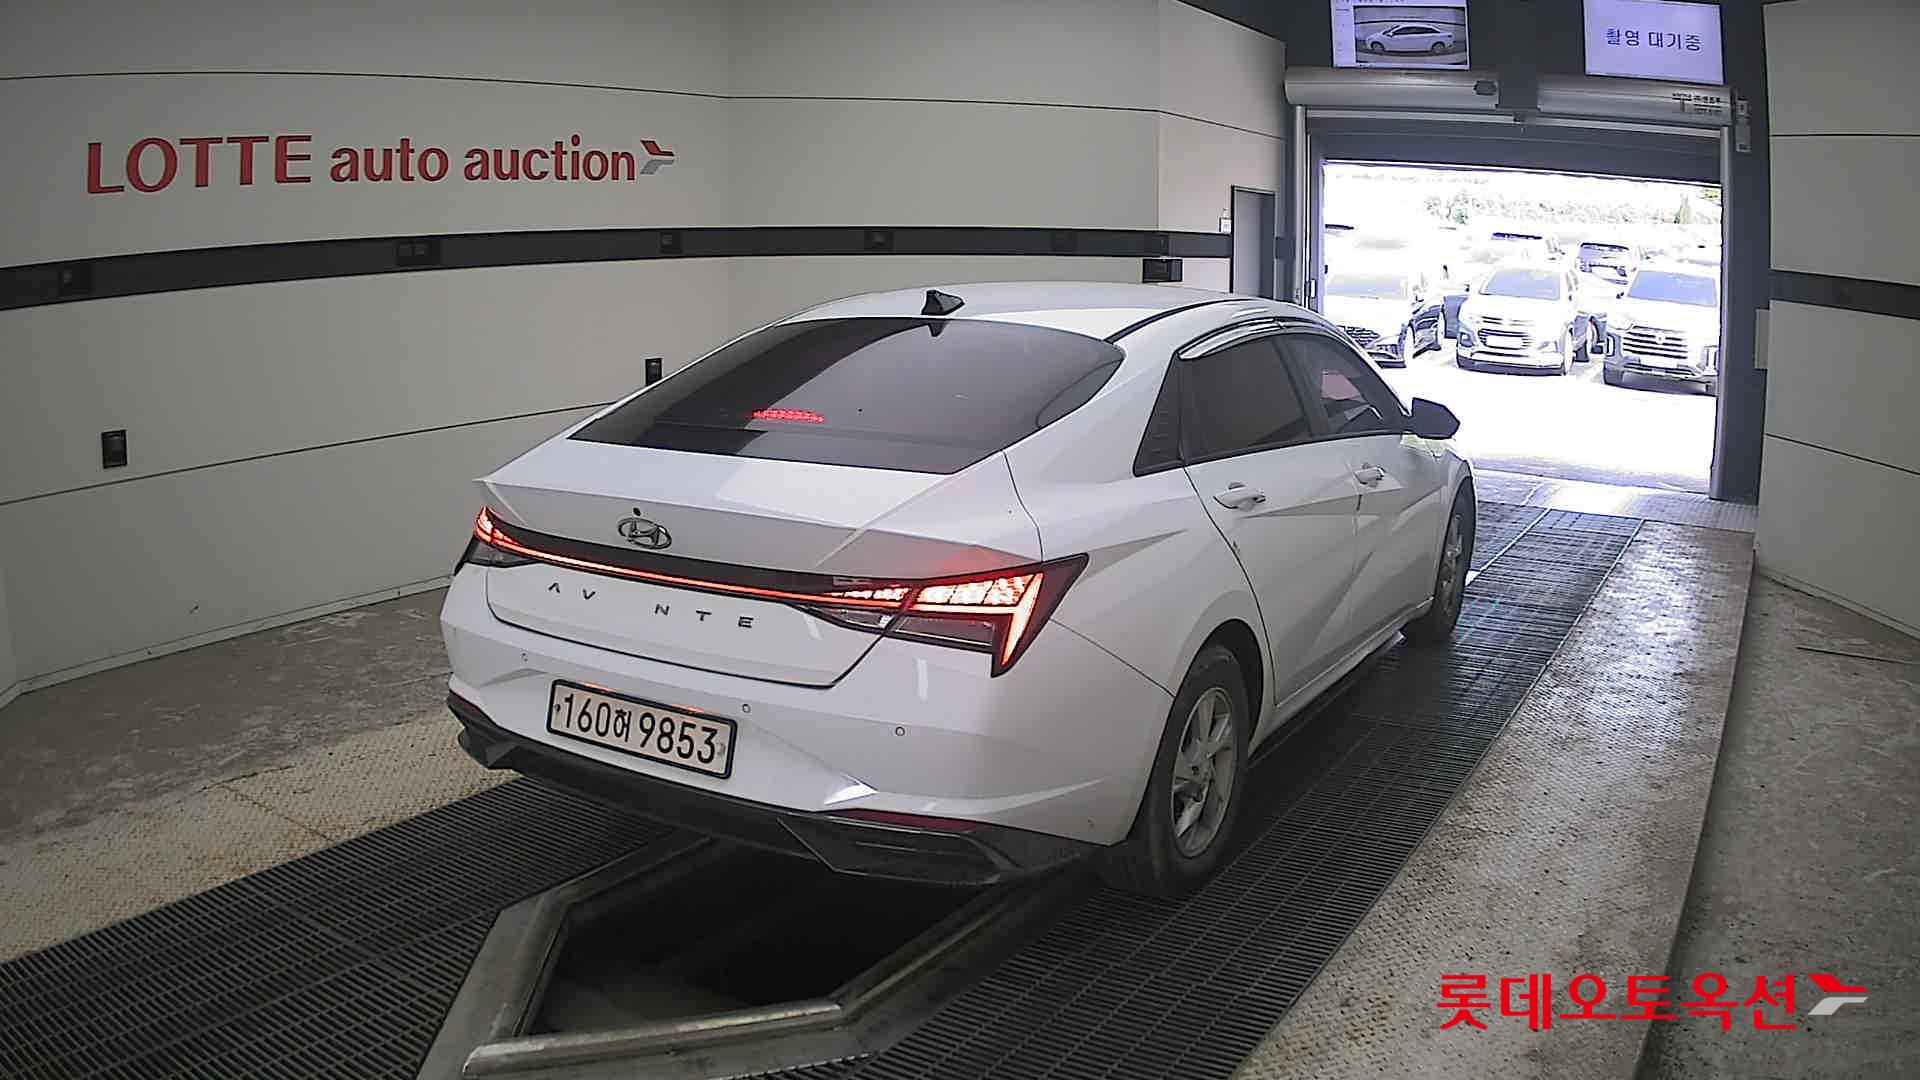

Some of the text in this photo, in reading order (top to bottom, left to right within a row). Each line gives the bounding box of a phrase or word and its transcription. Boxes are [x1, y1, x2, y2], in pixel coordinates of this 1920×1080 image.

[1648, 31, 1701, 52] 대기중
[87, 134, 636, 194] LOTTE auto auction
